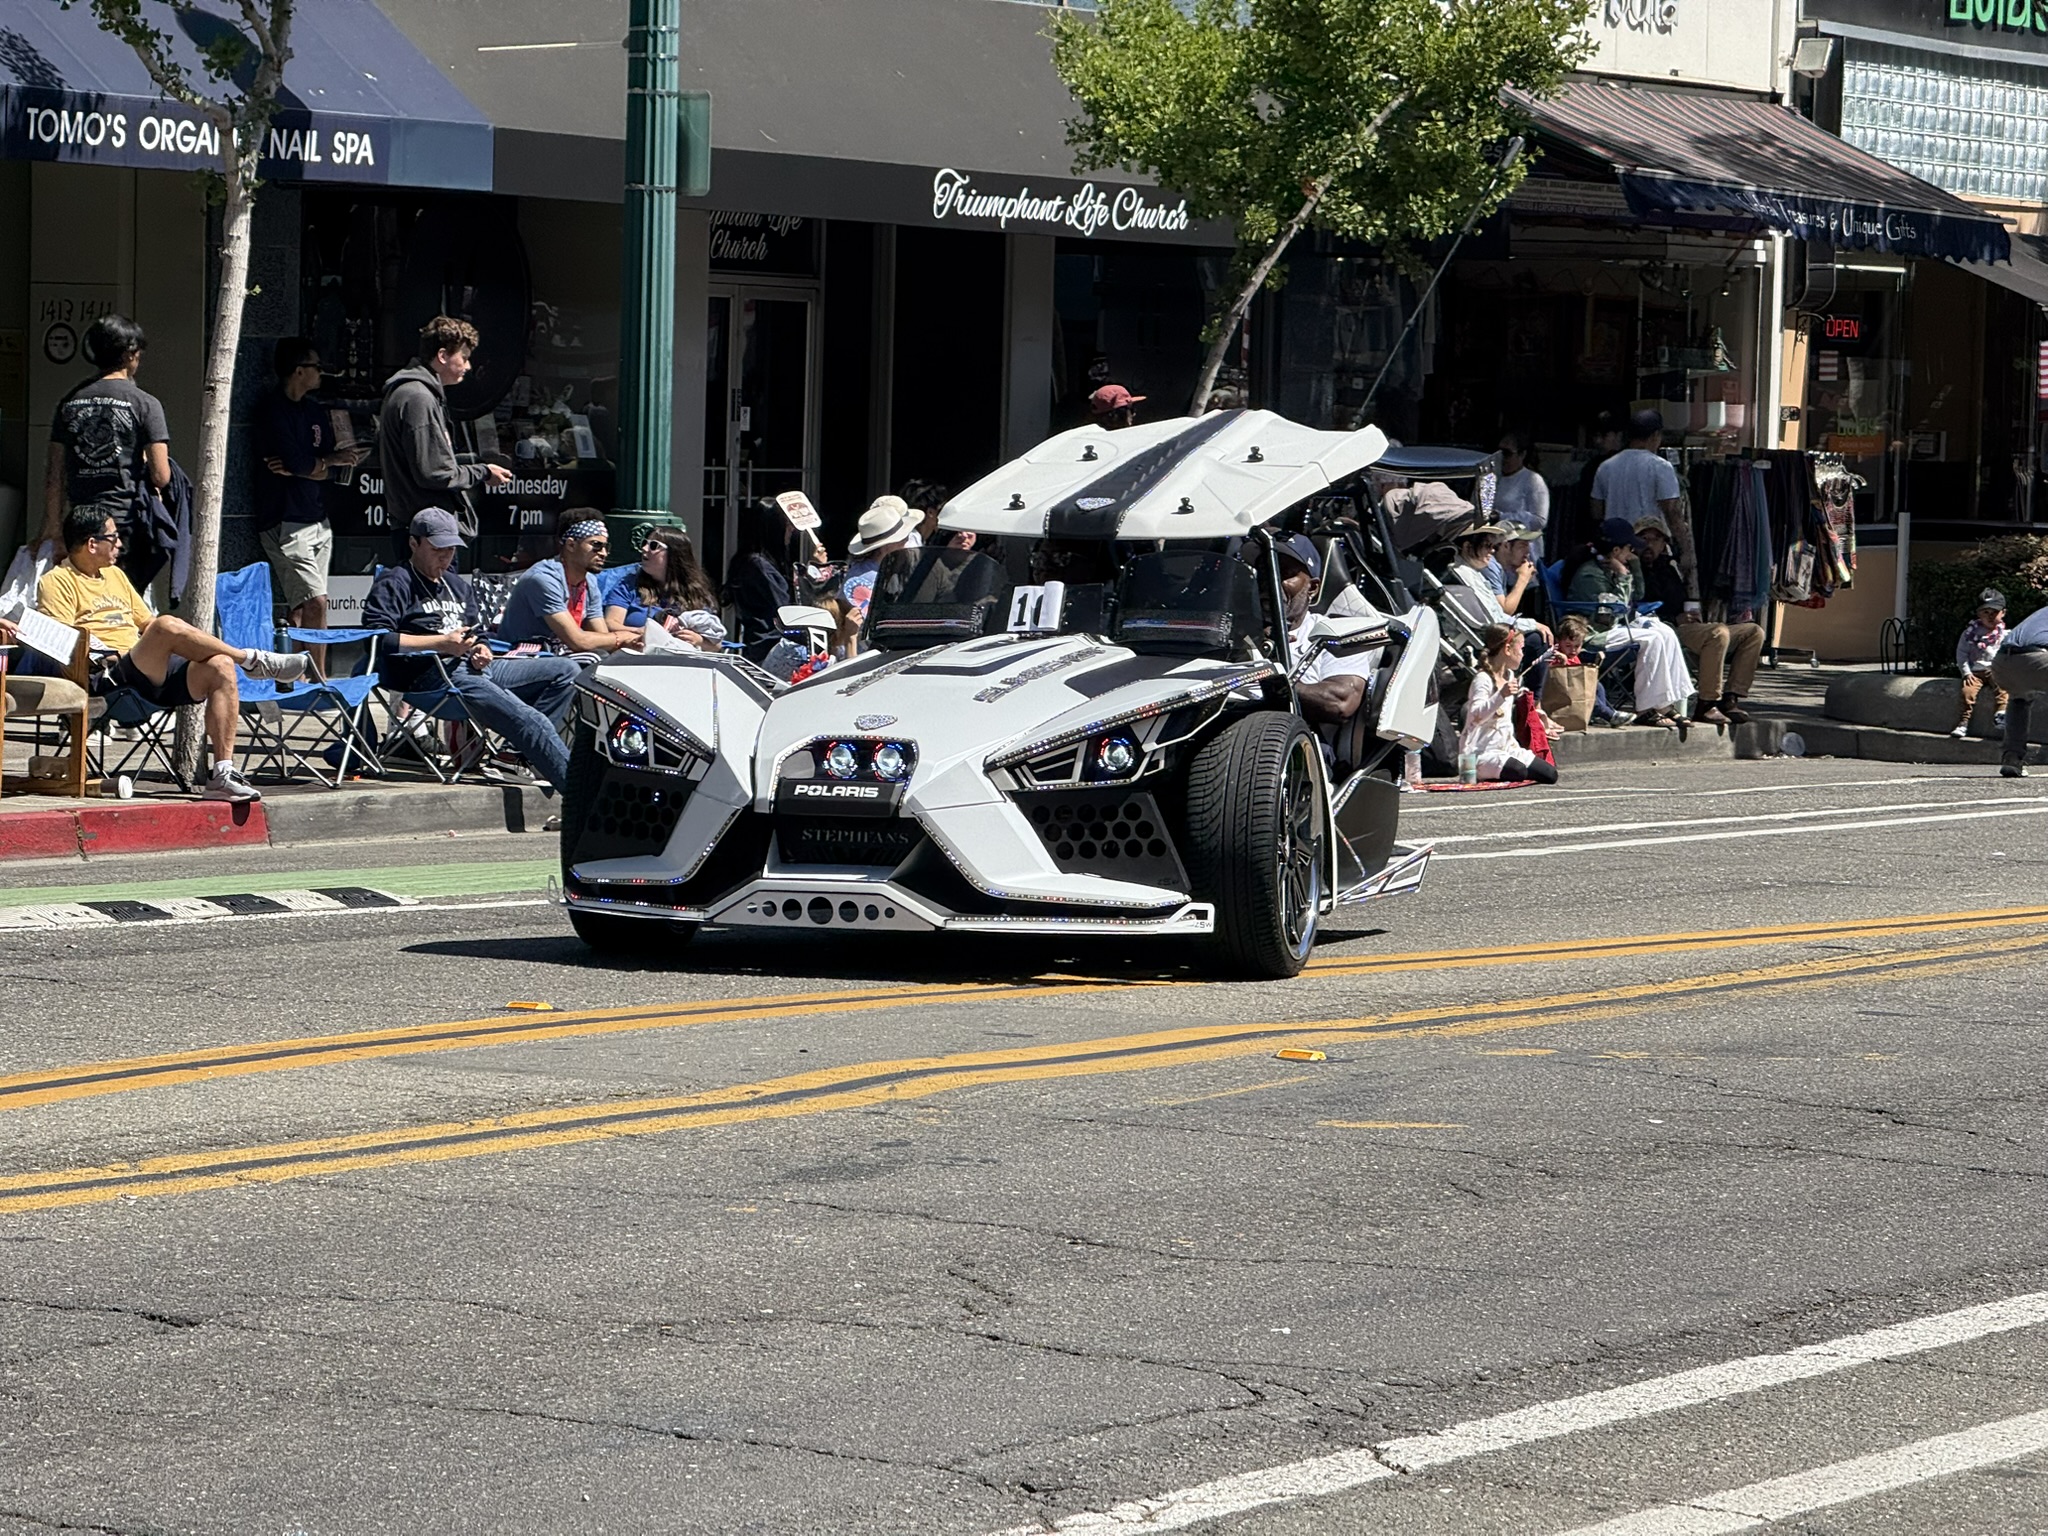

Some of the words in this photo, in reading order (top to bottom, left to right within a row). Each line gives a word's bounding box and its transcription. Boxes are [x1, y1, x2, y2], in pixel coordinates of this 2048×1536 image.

[26, 106, 126, 148] TOMO'S
[269, 127, 321, 162] NAIL
[331, 131, 374, 166] SPA
[933, 168, 1066, 229] Triumphant
[1065, 182, 1110, 236] Life
[1111, 187, 1189, 231] Church
[1771, 197, 1826, 228] Treasures
[1829, 207, 1839, 231] &
[1842, 207, 1883, 245] Unique
[1885, 212, 1917, 241] Gifts
[710, 229, 769, 261] Church
[40, 298, 74, 322] 1413
[1826, 318, 1860, 339] OPEN
[365, 505, 383, 526] 10
[508, 504, 518, 526] 7
[520, 510, 543, 531] pm
[793, 784, 879, 798] POLARIS
